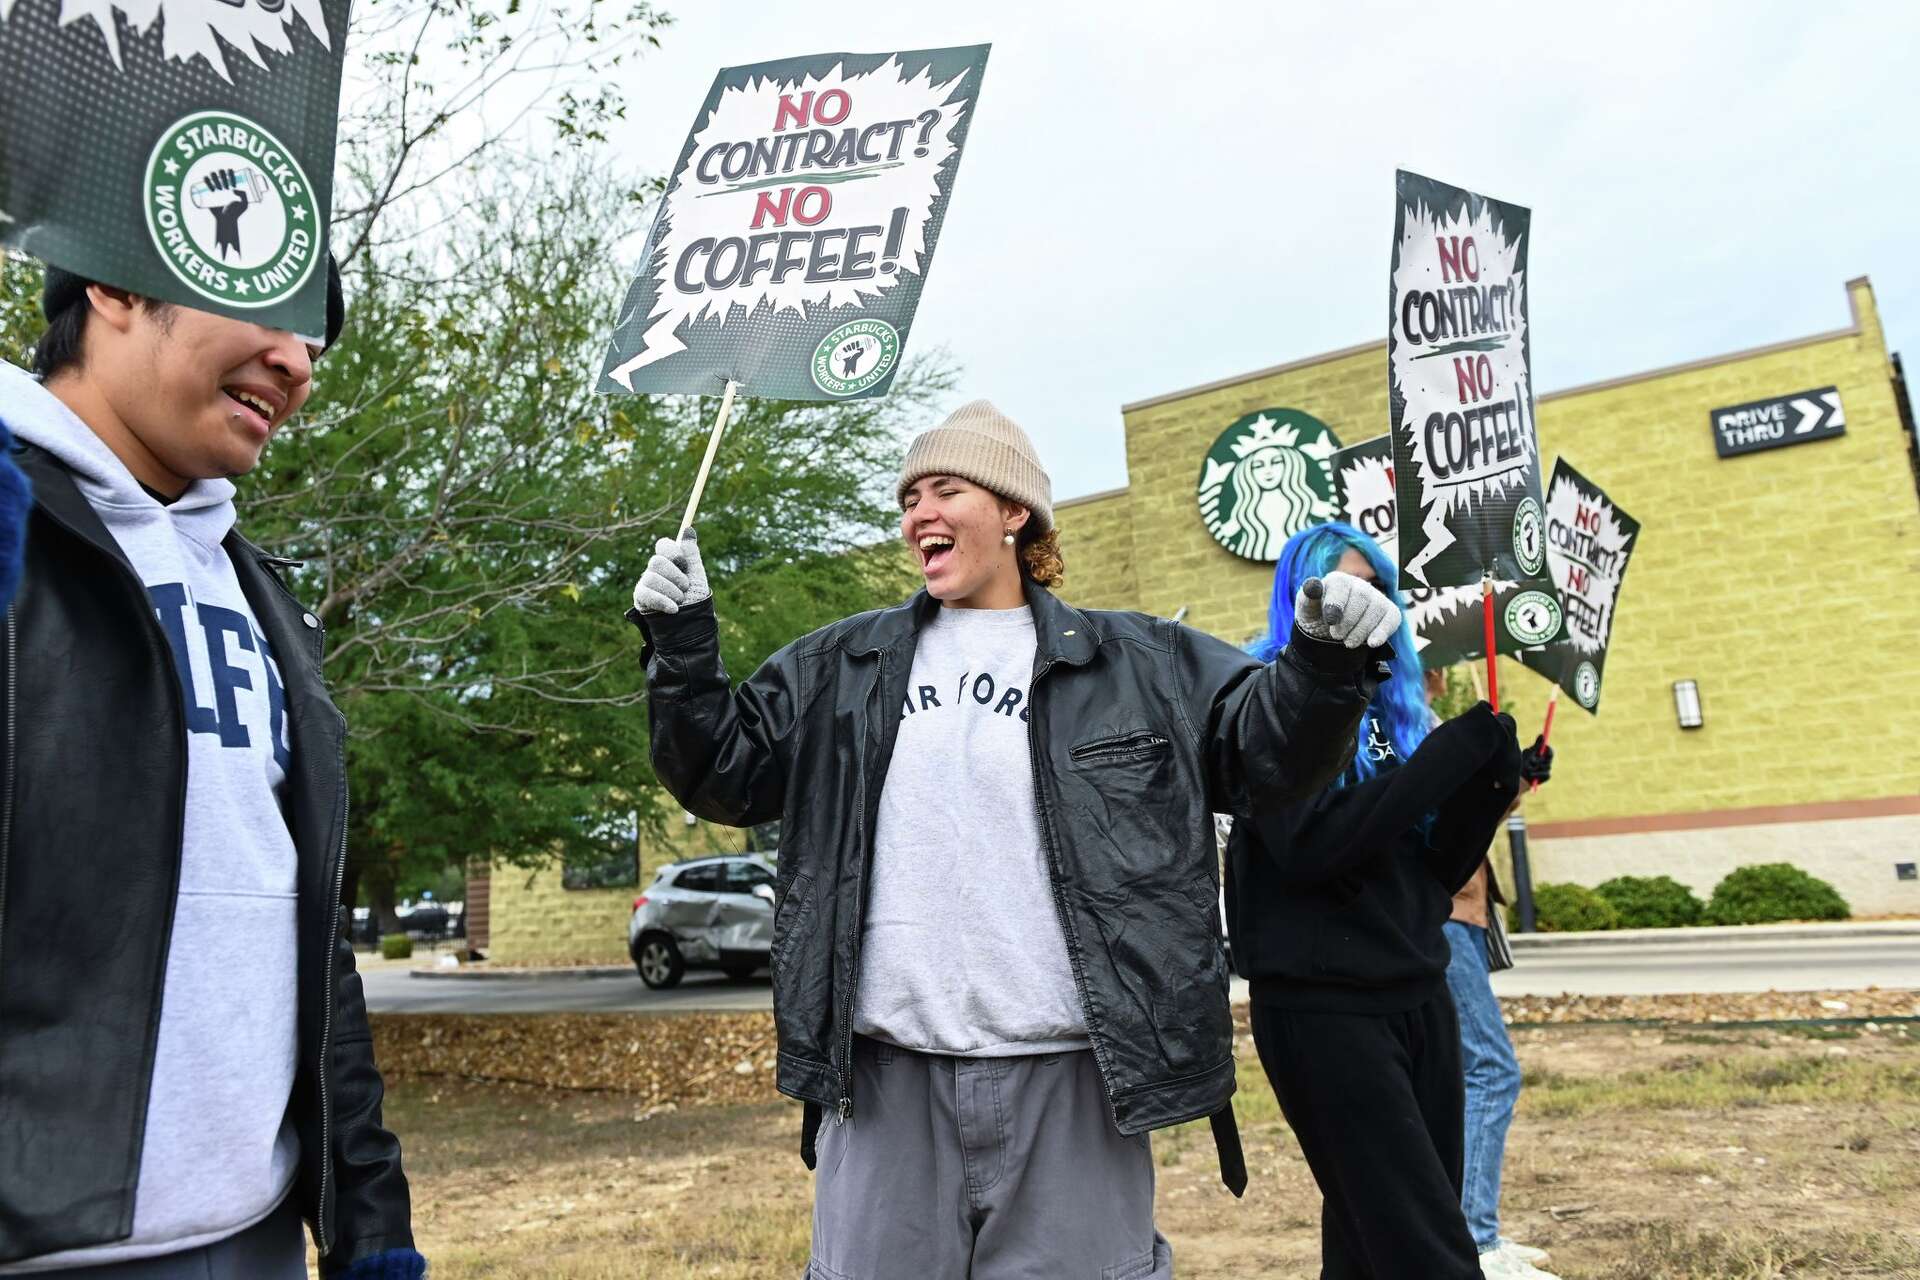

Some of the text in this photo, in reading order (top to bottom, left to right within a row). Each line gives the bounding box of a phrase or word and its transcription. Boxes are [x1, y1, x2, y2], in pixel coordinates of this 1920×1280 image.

[771, 87, 853, 133] NO
[175, 123, 303, 199] STARBUCKS
[695, 108, 943, 185] CONTRACT?
[748, 186, 834, 230] NO
[154, 184, 311, 294] WORKERS UNITED
[673, 206, 910, 295] COFFEE!
[1436, 235, 1480, 283] NO
[830, 322, 894, 344] STARBUCKS
[1401, 275, 1517, 346] CONTRACT?
[816, 353, 892, 391] WORKERS UNITED
[1453, 353, 1494, 405] NO
[1423, 381, 1529, 480] COFFEE!
[1717, 402, 1788, 432] DRIVE
[1723, 420, 1785, 448] THRU
[1574, 501, 1601, 536] NO
[1548, 517, 1619, 580] CONTRACT?
[1567, 564, 1591, 598] NO
